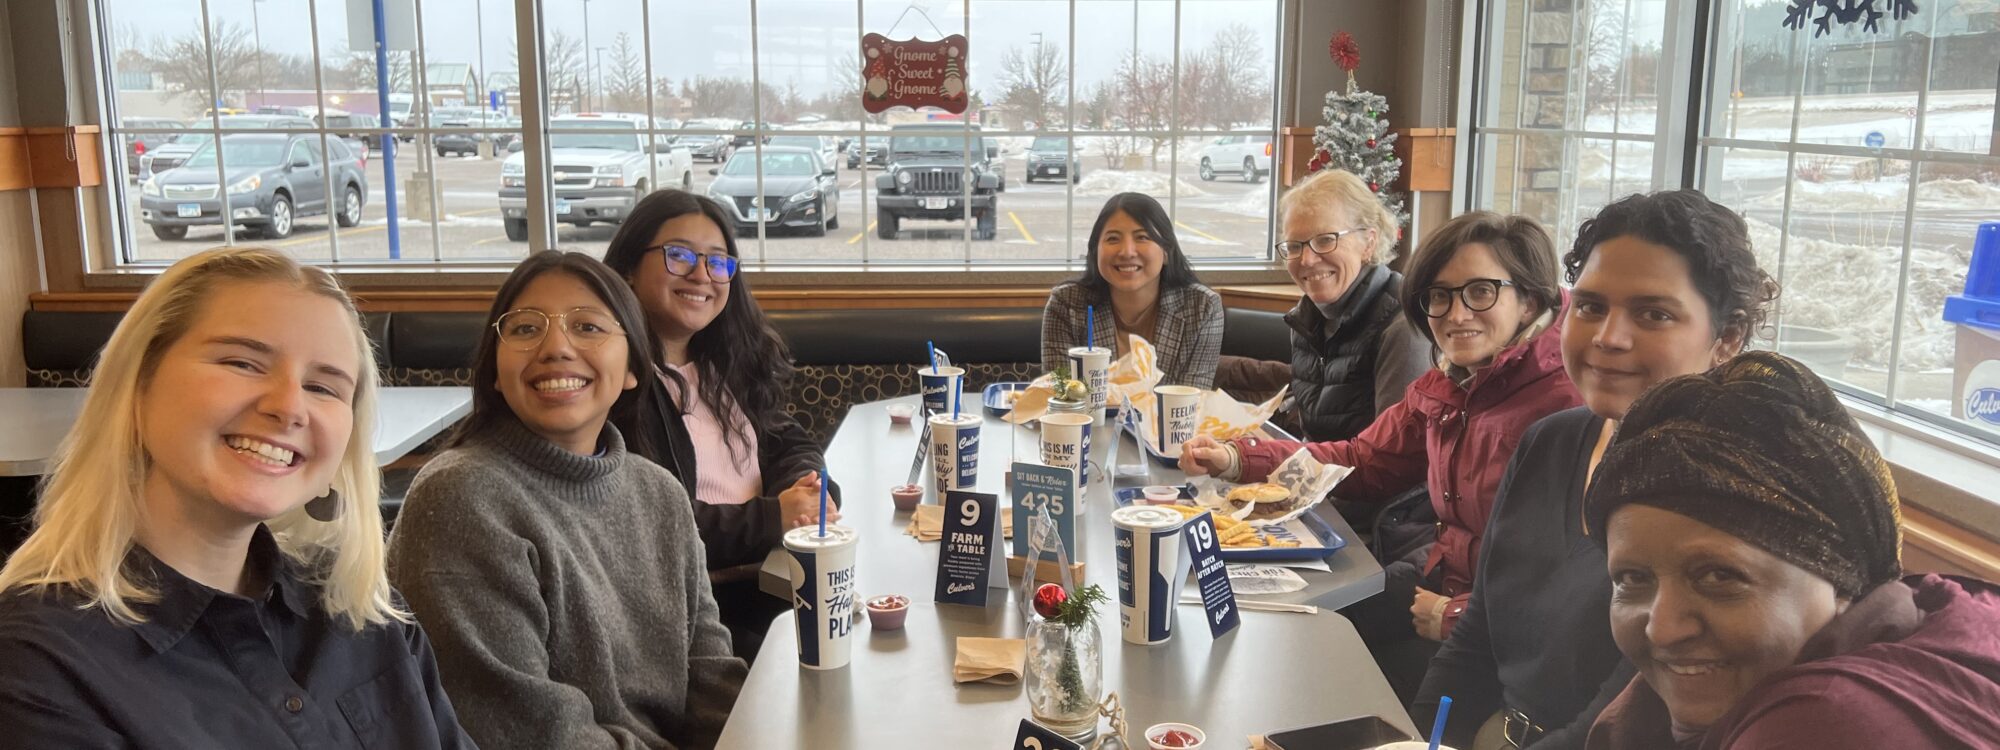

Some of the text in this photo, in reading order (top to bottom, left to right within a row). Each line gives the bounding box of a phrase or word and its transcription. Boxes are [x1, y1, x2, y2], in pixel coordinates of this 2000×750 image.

[894, 46, 937, 66] Gnome
[898, 64, 934, 79] Sweet
[894, 80, 937, 99] Gnome
[1053, 443, 1061, 454] IS
[1062, 444, 1075, 455] ME
[1026, 473, 1039, 482] BACK
[1021, 491, 1064, 515] 425
[960, 499, 981, 527] 9
[951, 532, 984, 545] FARM
[1189, 520, 1213, 553] 19
[957, 545, 985, 555] TABLE
[1201, 555, 1216, 568] BATCH
[1210, 560, 1224, 573] BATCH
[827, 568, 850, 587] THIS
[947, 582, 976, 594] Culver's
[829, 614, 853, 640] PLA
